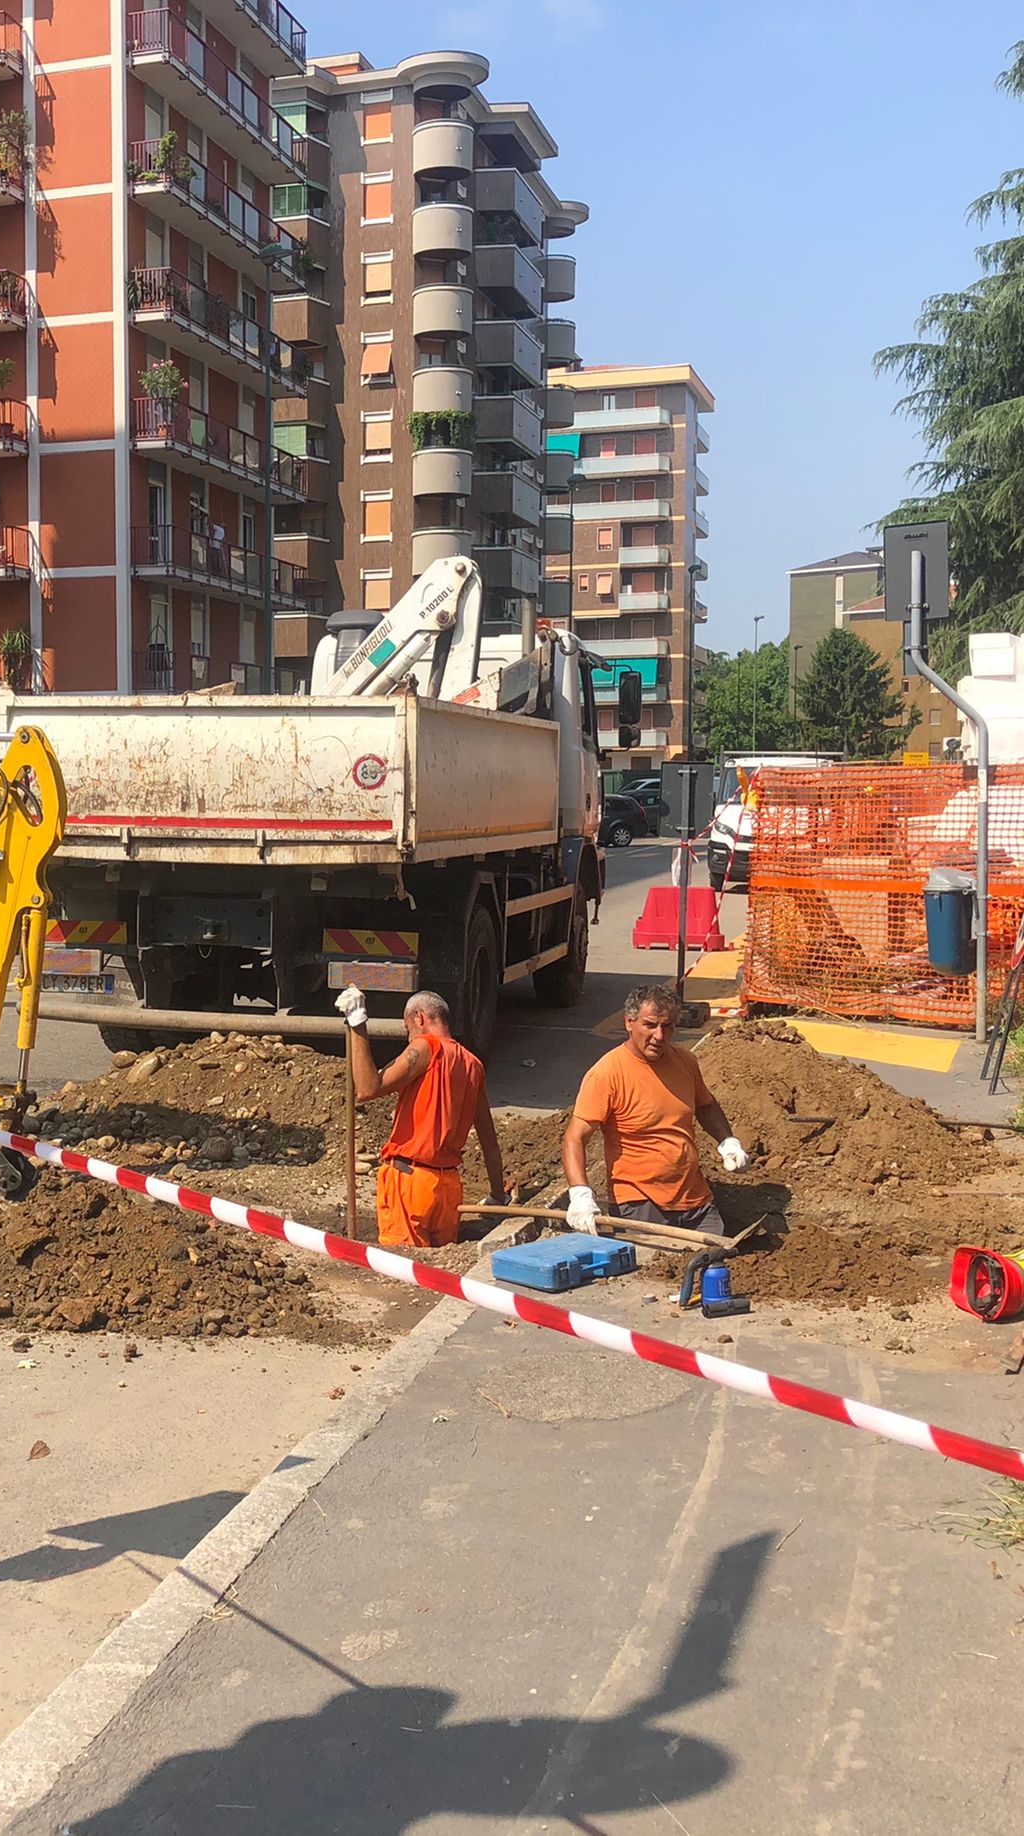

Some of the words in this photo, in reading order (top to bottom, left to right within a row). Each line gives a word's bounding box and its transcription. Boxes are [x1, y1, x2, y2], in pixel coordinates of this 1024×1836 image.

[350, 620, 393, 670] BONFIGLIOLI
[63, 976, 104, 991] 378ER
[114, 980, 134, 990] VECO
